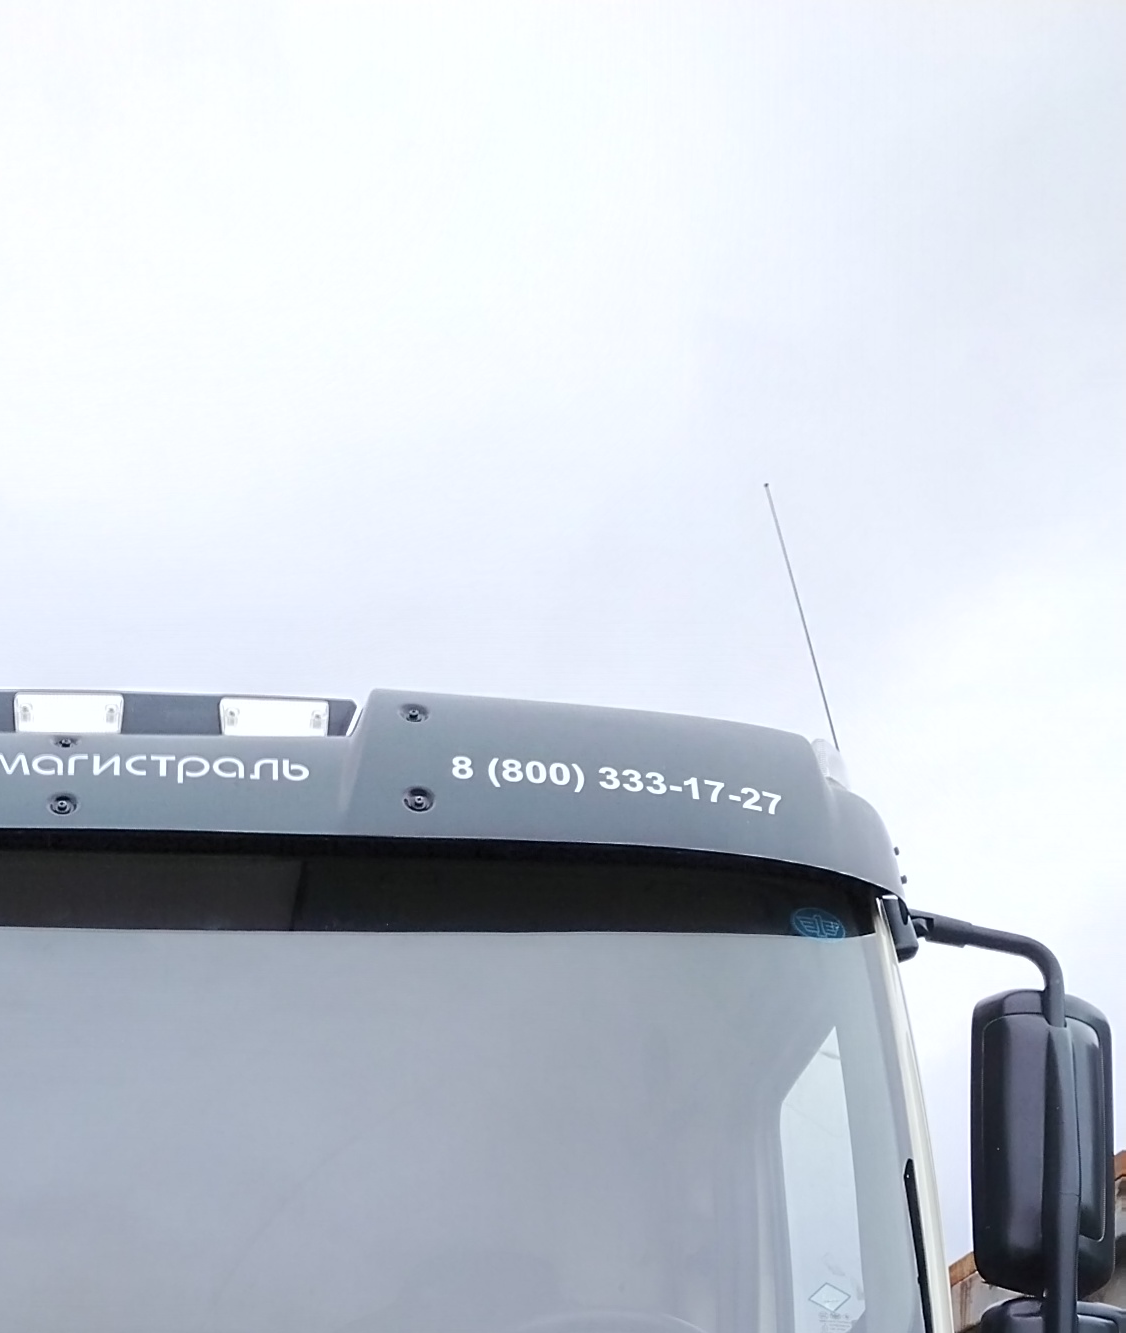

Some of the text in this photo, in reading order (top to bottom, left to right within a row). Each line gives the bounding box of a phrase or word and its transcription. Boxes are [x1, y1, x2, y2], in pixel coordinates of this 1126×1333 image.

[451, 755, 783, 815] 8 (800) 333-17-27
